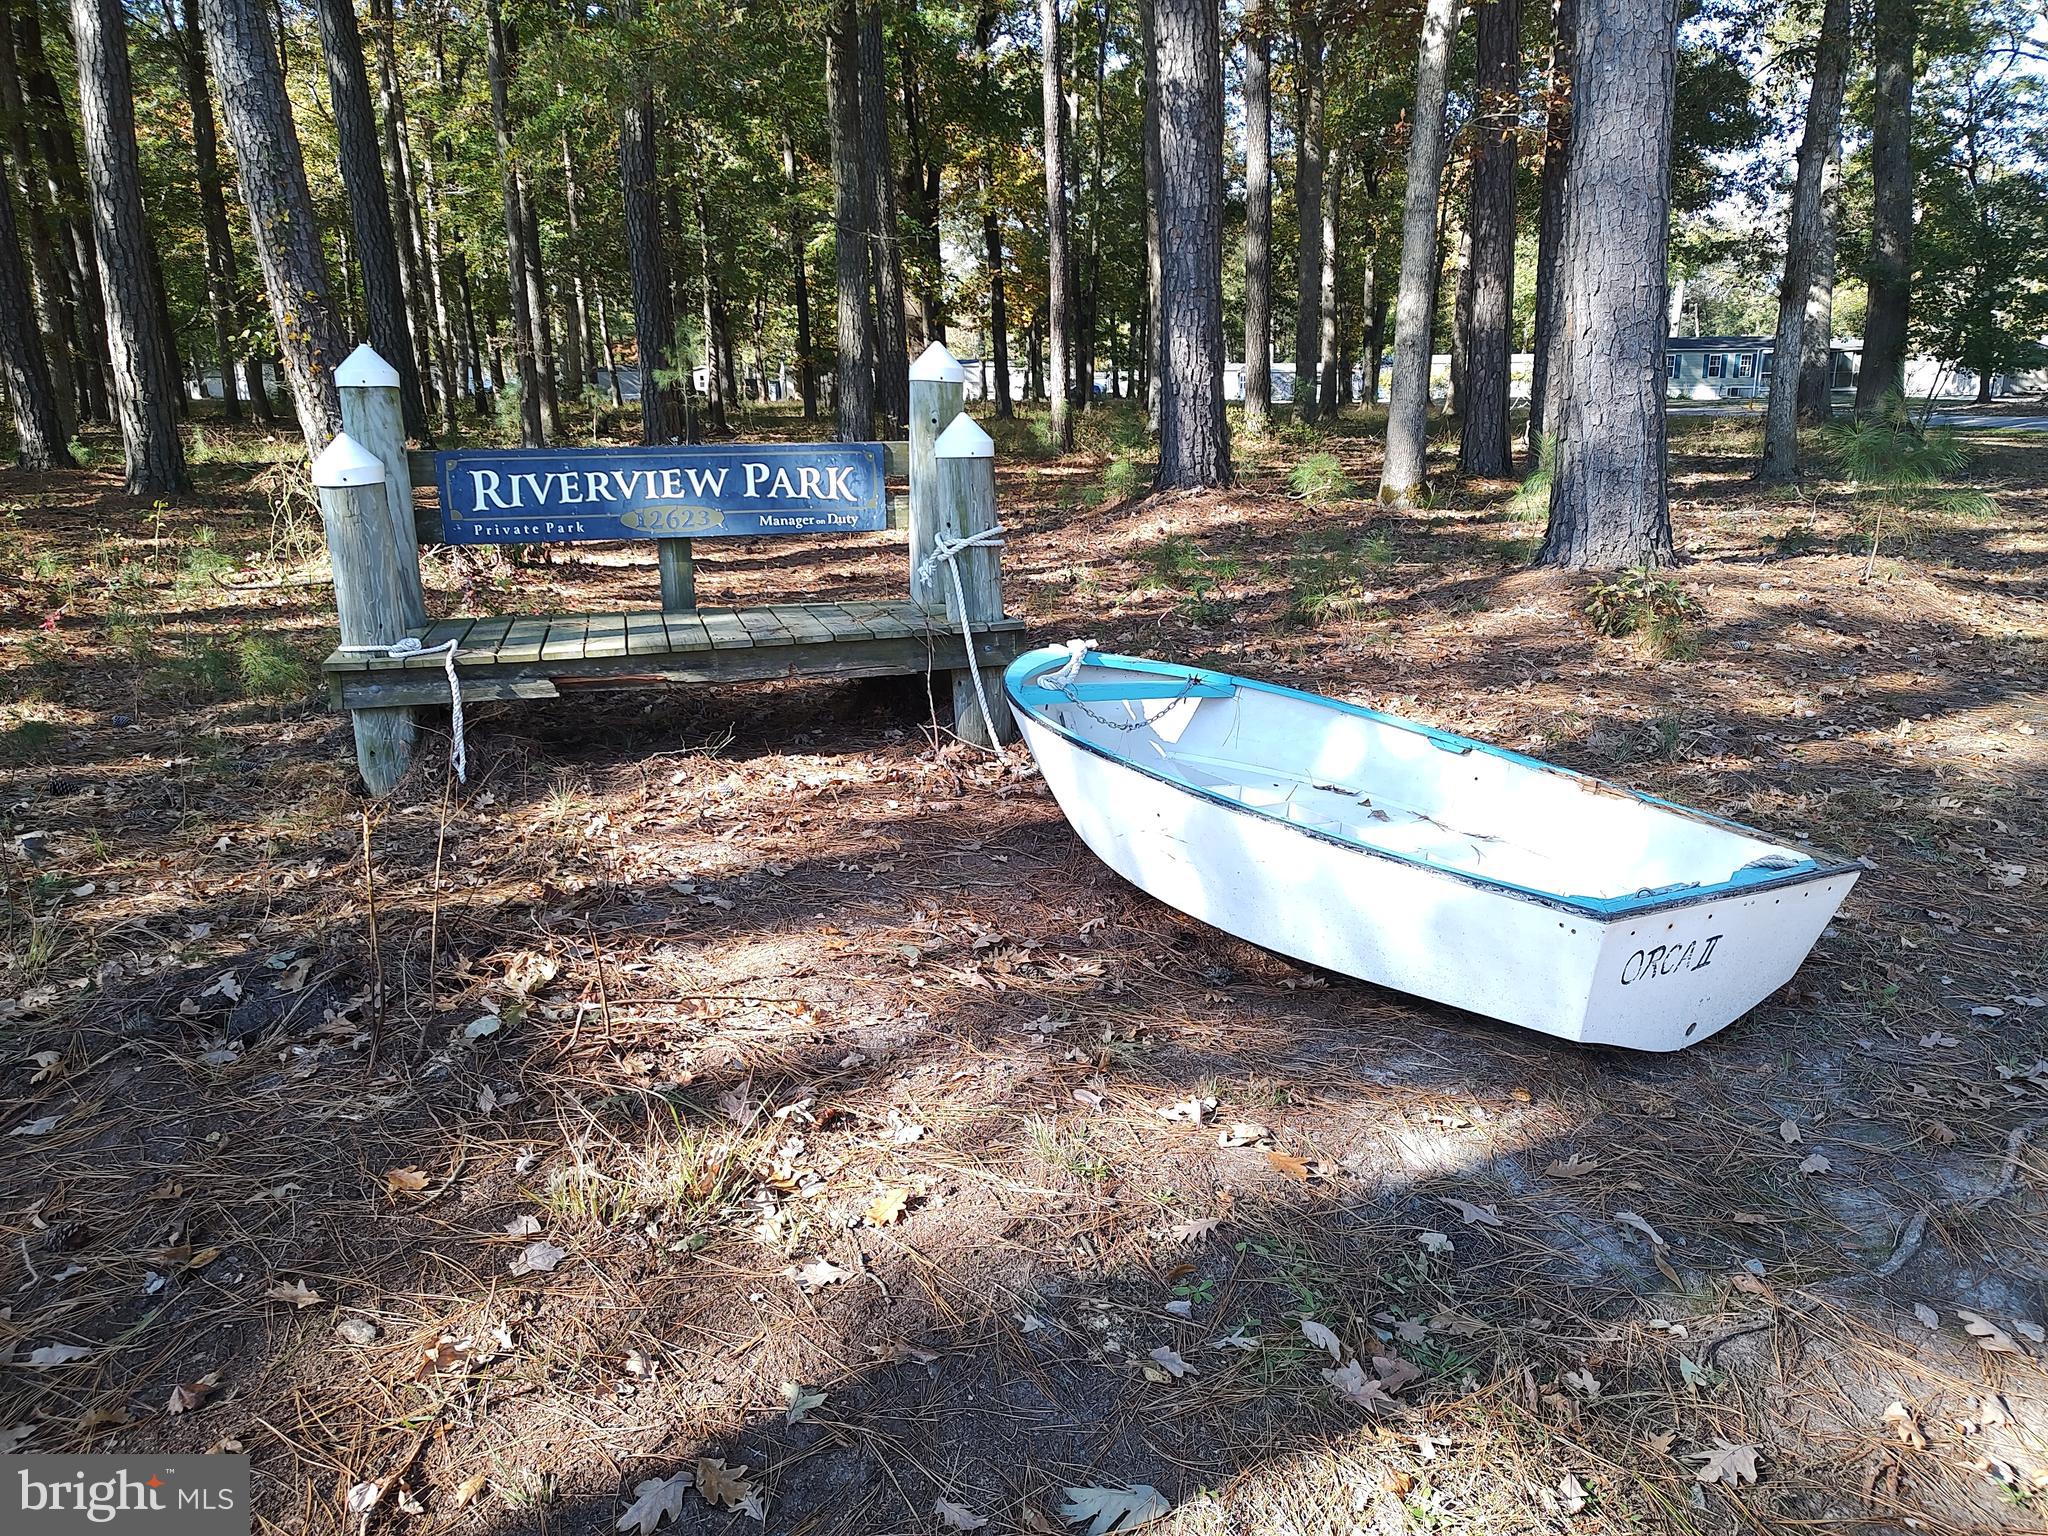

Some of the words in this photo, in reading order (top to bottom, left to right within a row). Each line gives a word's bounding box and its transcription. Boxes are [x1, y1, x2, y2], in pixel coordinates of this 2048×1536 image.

[469, 467, 729, 512] RIVERVIEW
[742, 463, 858, 501] PARK
[474, 522, 540, 536] Private
[546, 521, 585, 534] Park
[634, 505, 709, 530] 12623
[759, 514, 815, 528] Manager
[827, 513, 859, 527] Duty
[1620, 940, 1697, 985] ORCA
[1690, 934, 1724, 972] II
